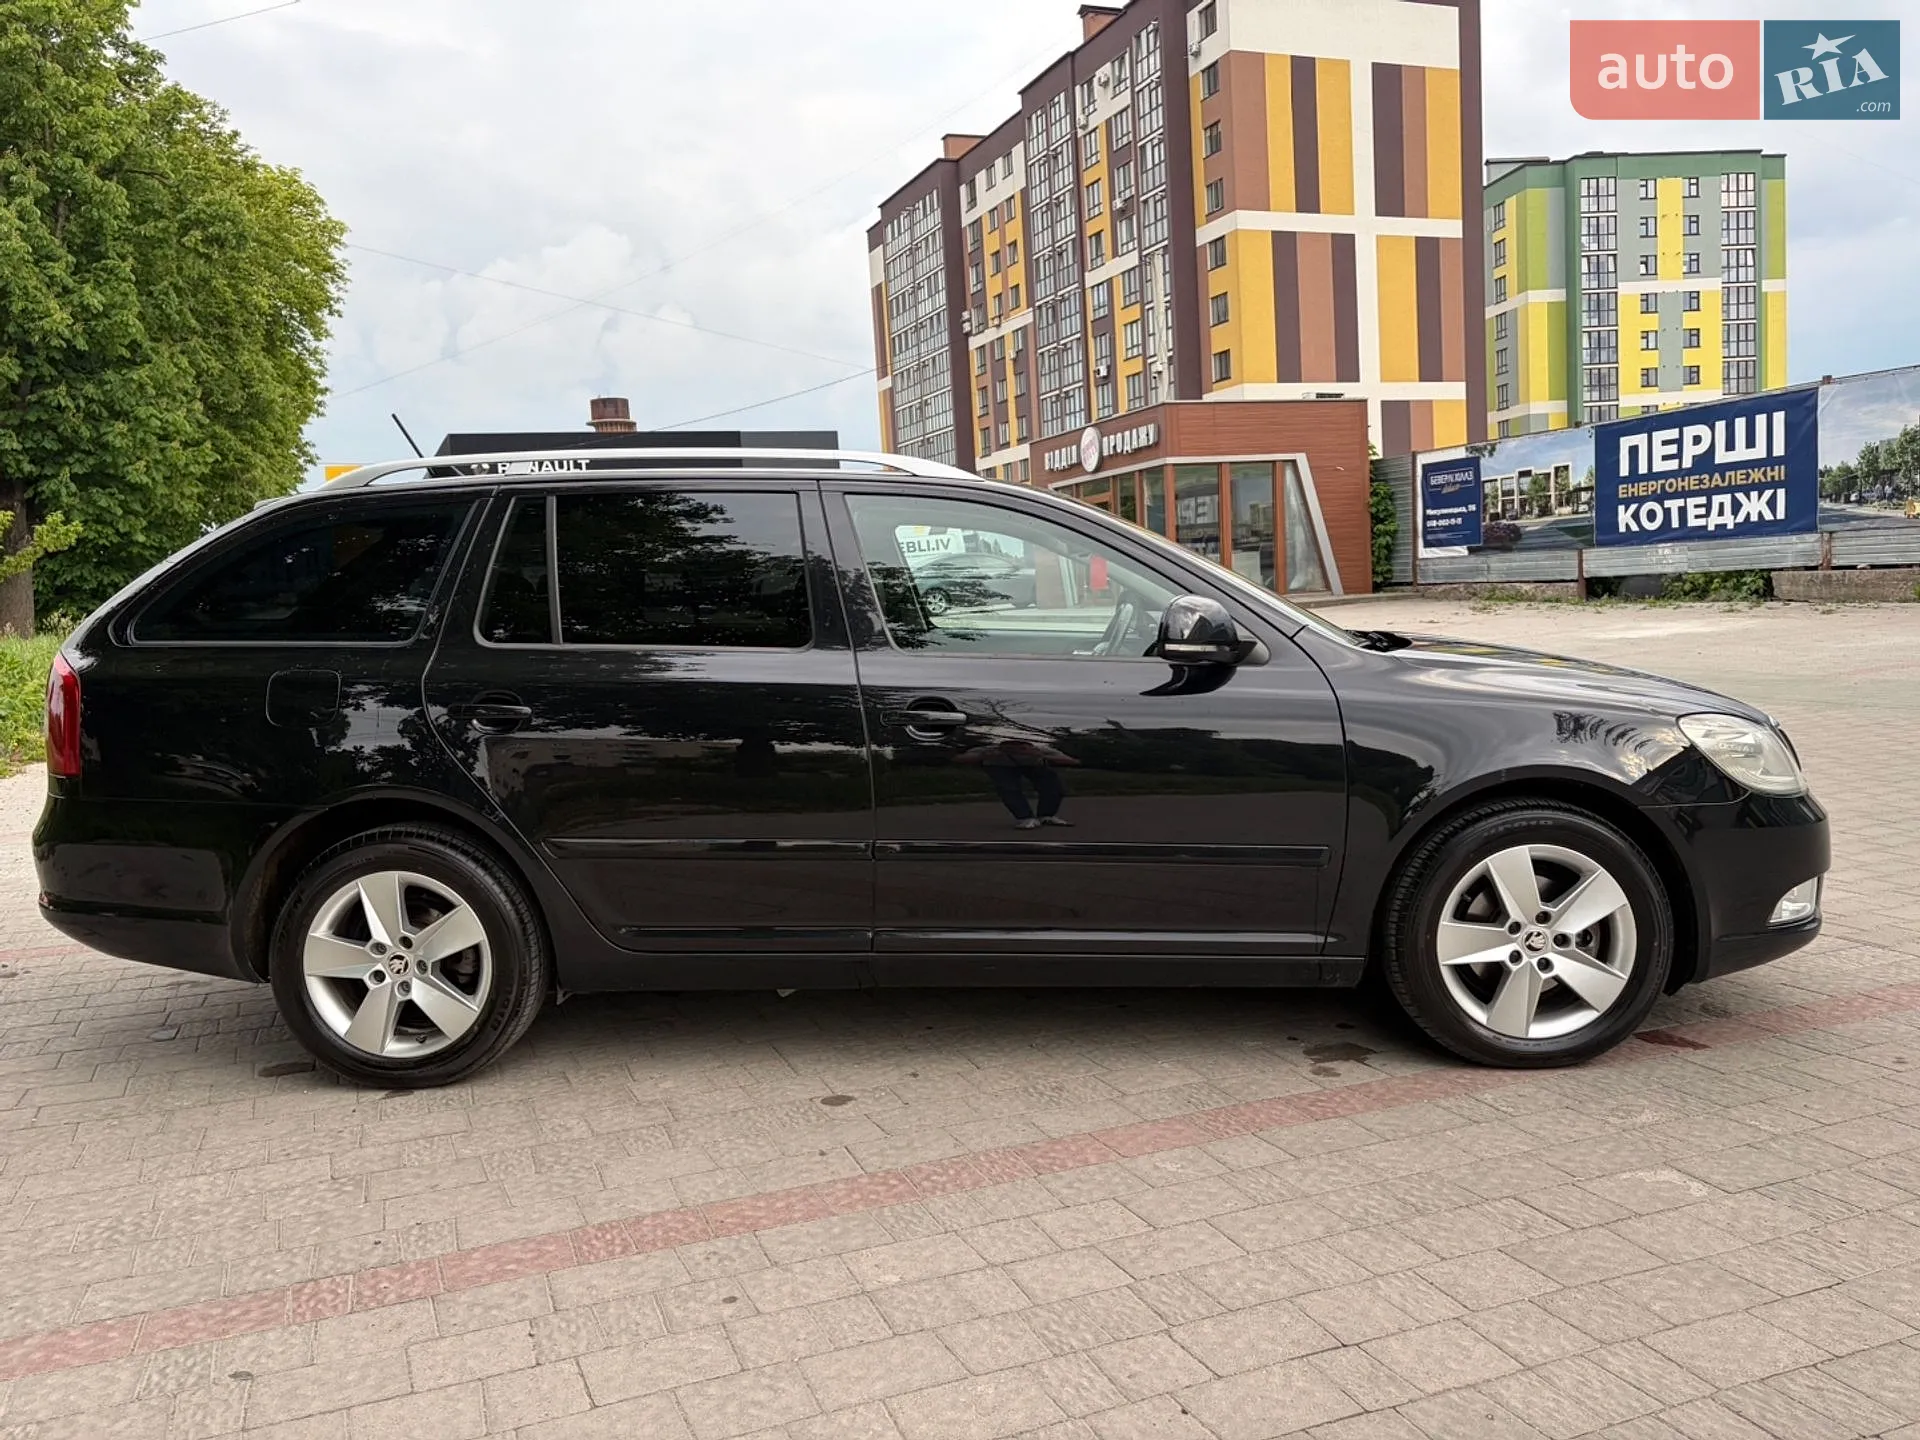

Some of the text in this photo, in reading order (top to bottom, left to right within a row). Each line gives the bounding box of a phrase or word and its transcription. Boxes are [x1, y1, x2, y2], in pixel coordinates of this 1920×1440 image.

[1102, 423, 1156, 456] ПРОДАЖУ
[1618, 411, 1786, 477] ПЕРШІ
[497, 459, 590, 474] RNAULT
[1618, 465, 1786, 498] ЕНЕРГОНЕЗАЛЕЖНІ
[1618, 488, 1786, 532] КОТЕДЖІ
